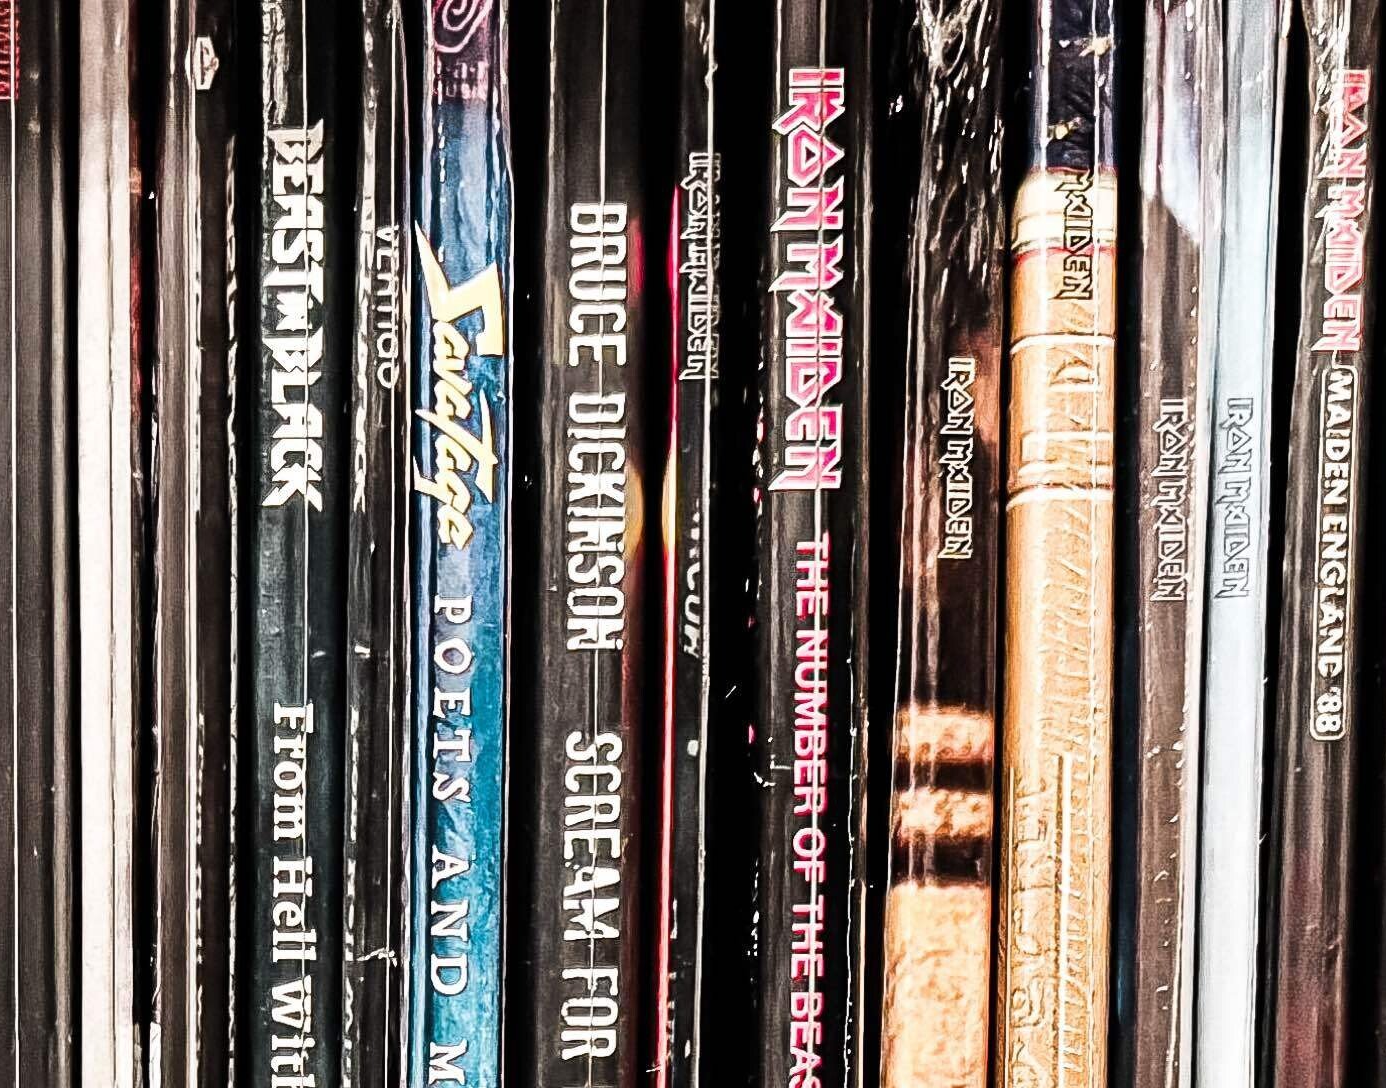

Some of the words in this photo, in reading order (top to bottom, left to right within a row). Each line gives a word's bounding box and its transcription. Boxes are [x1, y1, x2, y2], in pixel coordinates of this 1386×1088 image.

[769, 68, 846, 232] IRON
[569, 203, 626, 366] BRUCE
[1312, 184, 1366, 350] MAIDEN
[414, 222, 504, 553] Savatage
[769, 240, 844, 492] MAIDEN
[941, 358, 976, 434] IRON
[939, 438, 974, 558] MAIDEN
[1154, 400, 1190, 478] IRON
[1216, 398, 1256, 474] IRON
[1321, 372, 1356, 505] MAIDEN
[567, 392, 624, 650] DICKINSON
[794, 530, 831, 617] THE
[1152, 480, 1190, 601] MAIDEN
[1214, 478, 1252, 597] MAIDEN
[1317, 514, 1351, 676] ENGLAND
[432, 596, 474, 802] POETS
[794, 630, 829, 812] NUMBER
[271, 702, 315, 842] From
[562, 730, 622, 940] SCREAM
[270, 856, 317, 962] Hell
[794, 828, 826, 880] OF
[429, 851, 471, 995] AND
[792, 898, 824, 980] THE
[560, 970, 618, 1060] FOR
